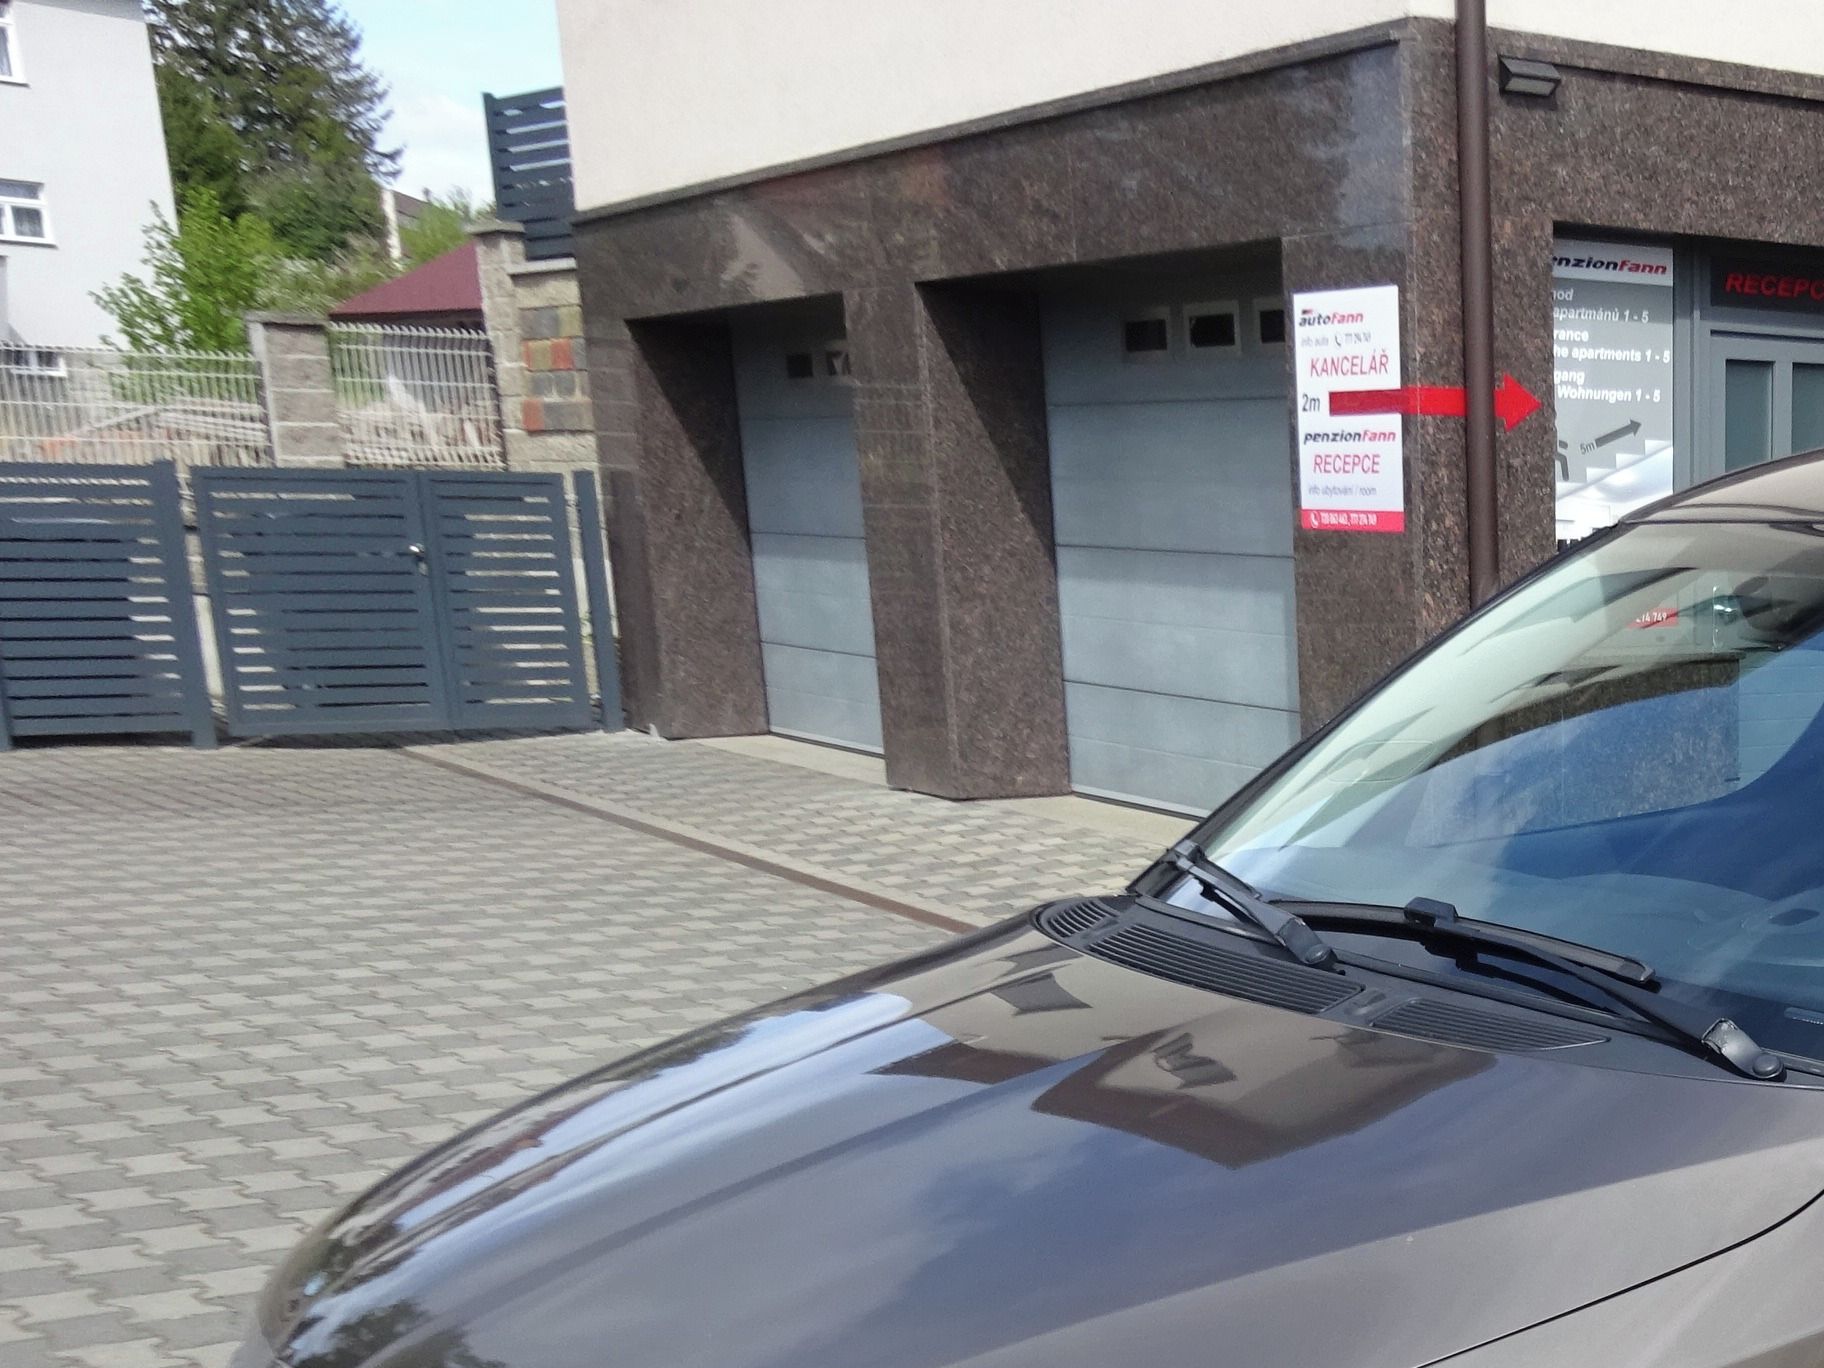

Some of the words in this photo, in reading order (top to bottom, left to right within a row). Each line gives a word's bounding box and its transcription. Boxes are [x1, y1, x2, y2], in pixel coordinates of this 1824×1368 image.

[1297, 311, 1364, 327] autofann
[1624, 309, 1630, 322] 1
[1641, 310, 1649, 323] 5
[1310, 348, 1389, 377] KANCELÁŘ
[1572, 347, 1641, 362] apartments
[1646, 349, 1652, 362] 1
[1663, 350, 1670, 363] 5
[1558, 384, 1631, 403] Wohnungen
[1635, 388, 1642, 402] 1
[1653, 389, 1661, 403] 5
[1302, 393, 1321, 412] 2m
[1304, 428, 1396, 445] penzionfann
[1580, 441, 1595, 455] 5m
[1313, 454, 1381, 474] RECEPCE
